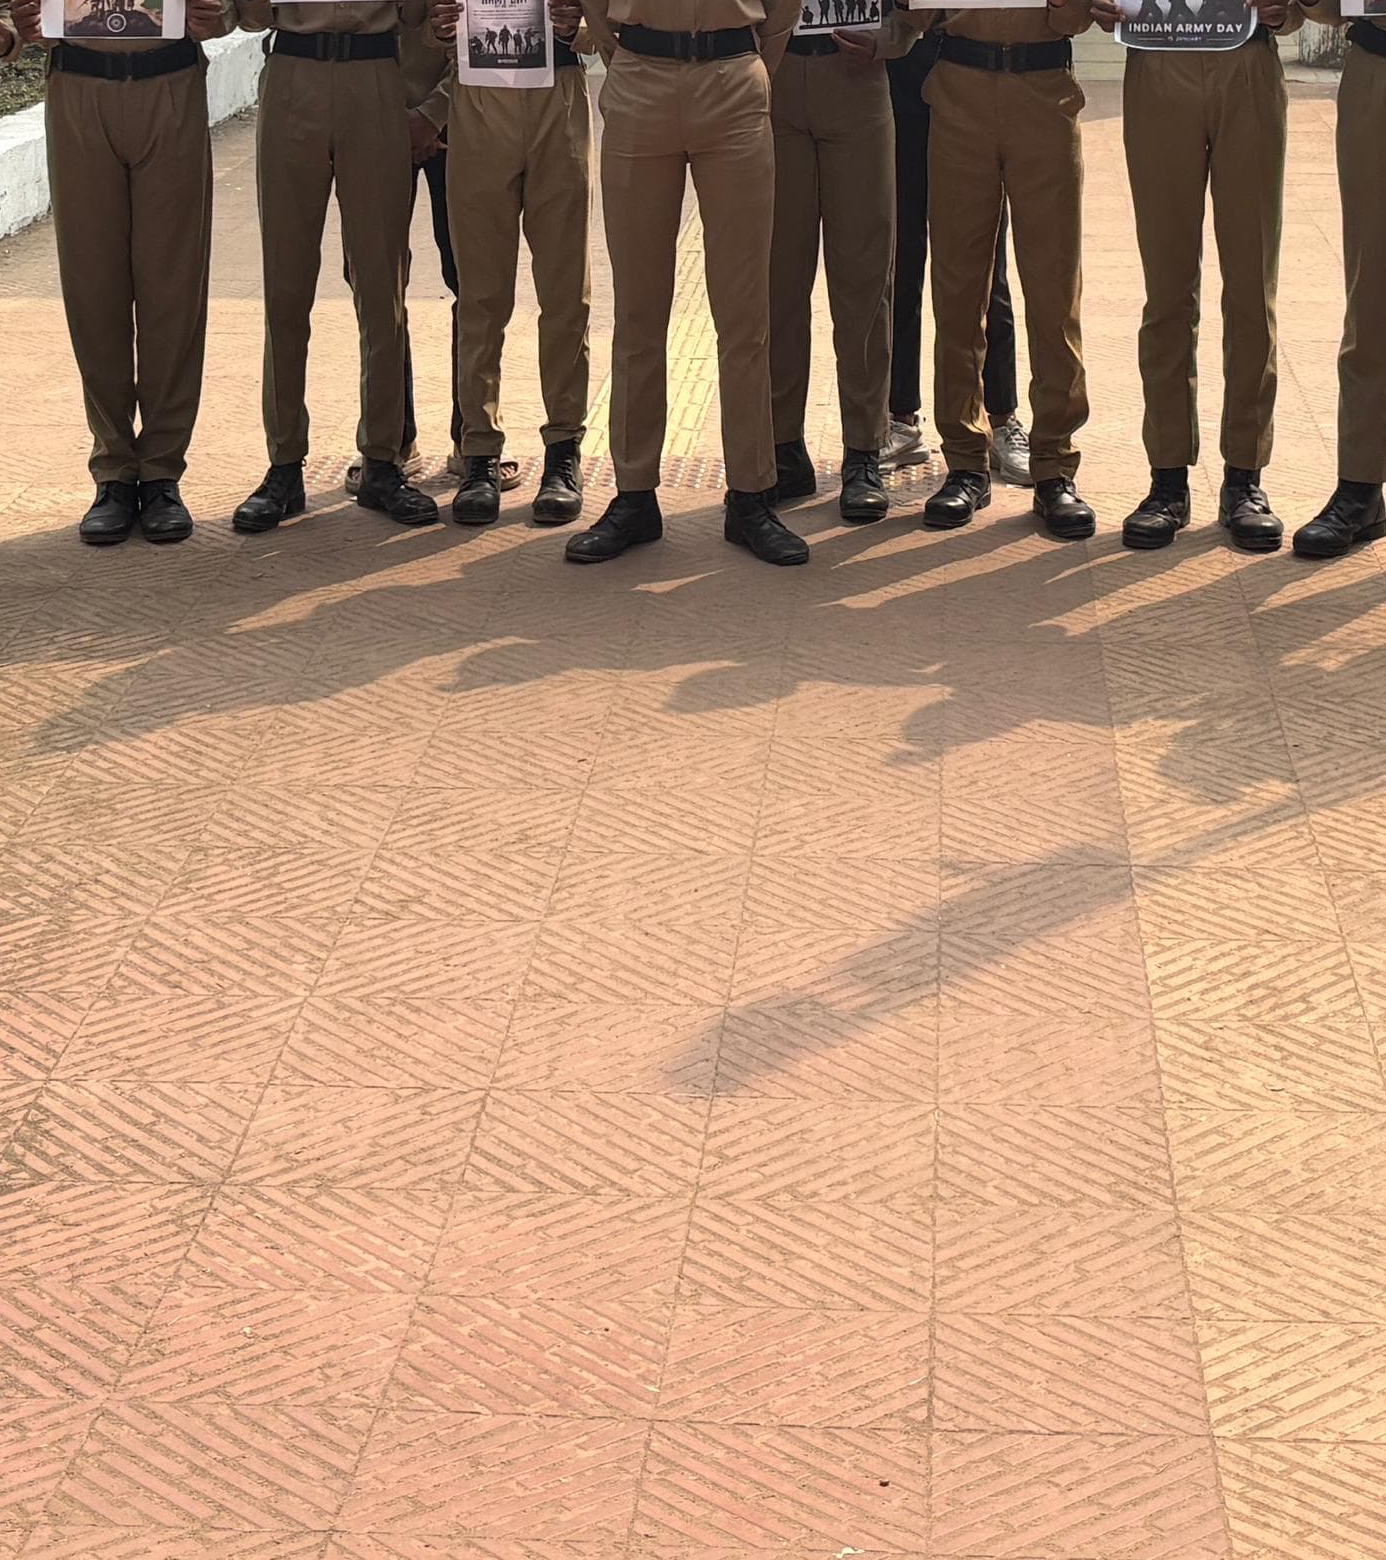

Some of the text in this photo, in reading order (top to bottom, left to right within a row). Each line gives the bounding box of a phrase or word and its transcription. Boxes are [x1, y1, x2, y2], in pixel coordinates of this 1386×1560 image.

[1128, 23, 1243, 33] INDIAN ARMY DAY
